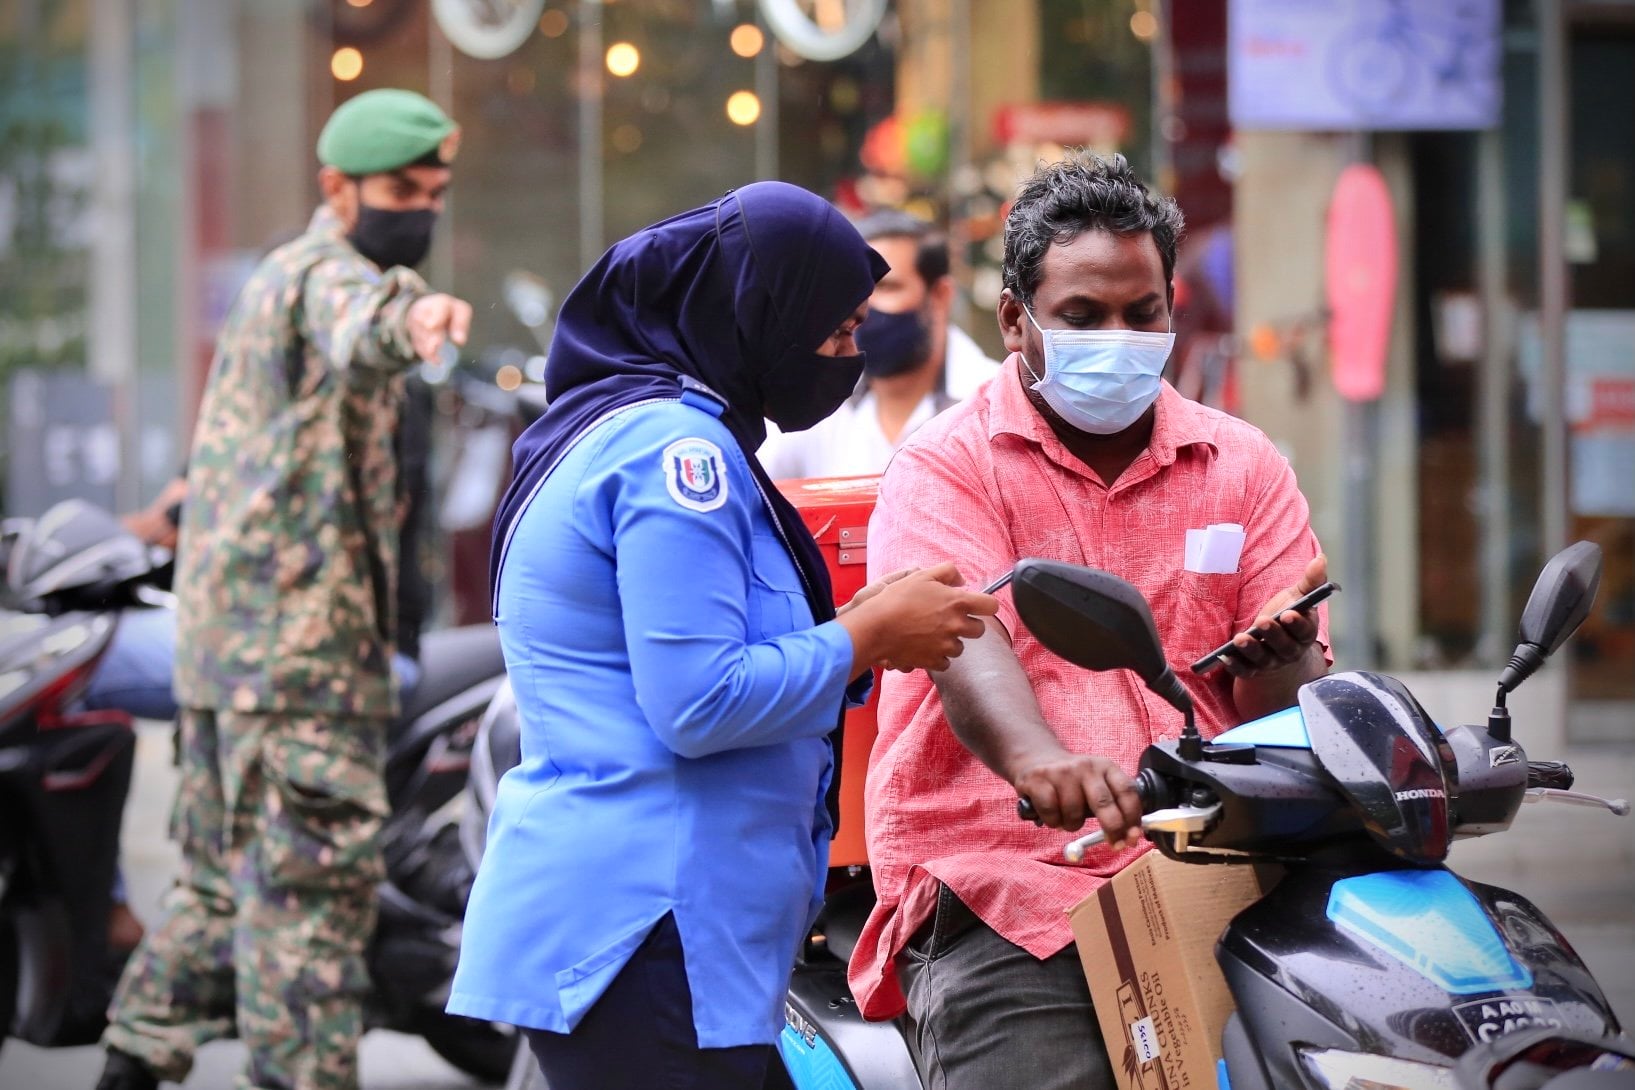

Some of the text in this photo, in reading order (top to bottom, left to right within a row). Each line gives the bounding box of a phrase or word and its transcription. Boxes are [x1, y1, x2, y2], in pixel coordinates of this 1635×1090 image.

[1395, 789, 1445, 801] HONDA
[1146, 865, 1158, 900] Maldives
[1159, 910, 1170, 940] Product
[1151, 972, 1163, 996] Oil
[1140, 971, 1167, 1049] CHUNKS
[1160, 999, 1184, 1072] Vegetable
